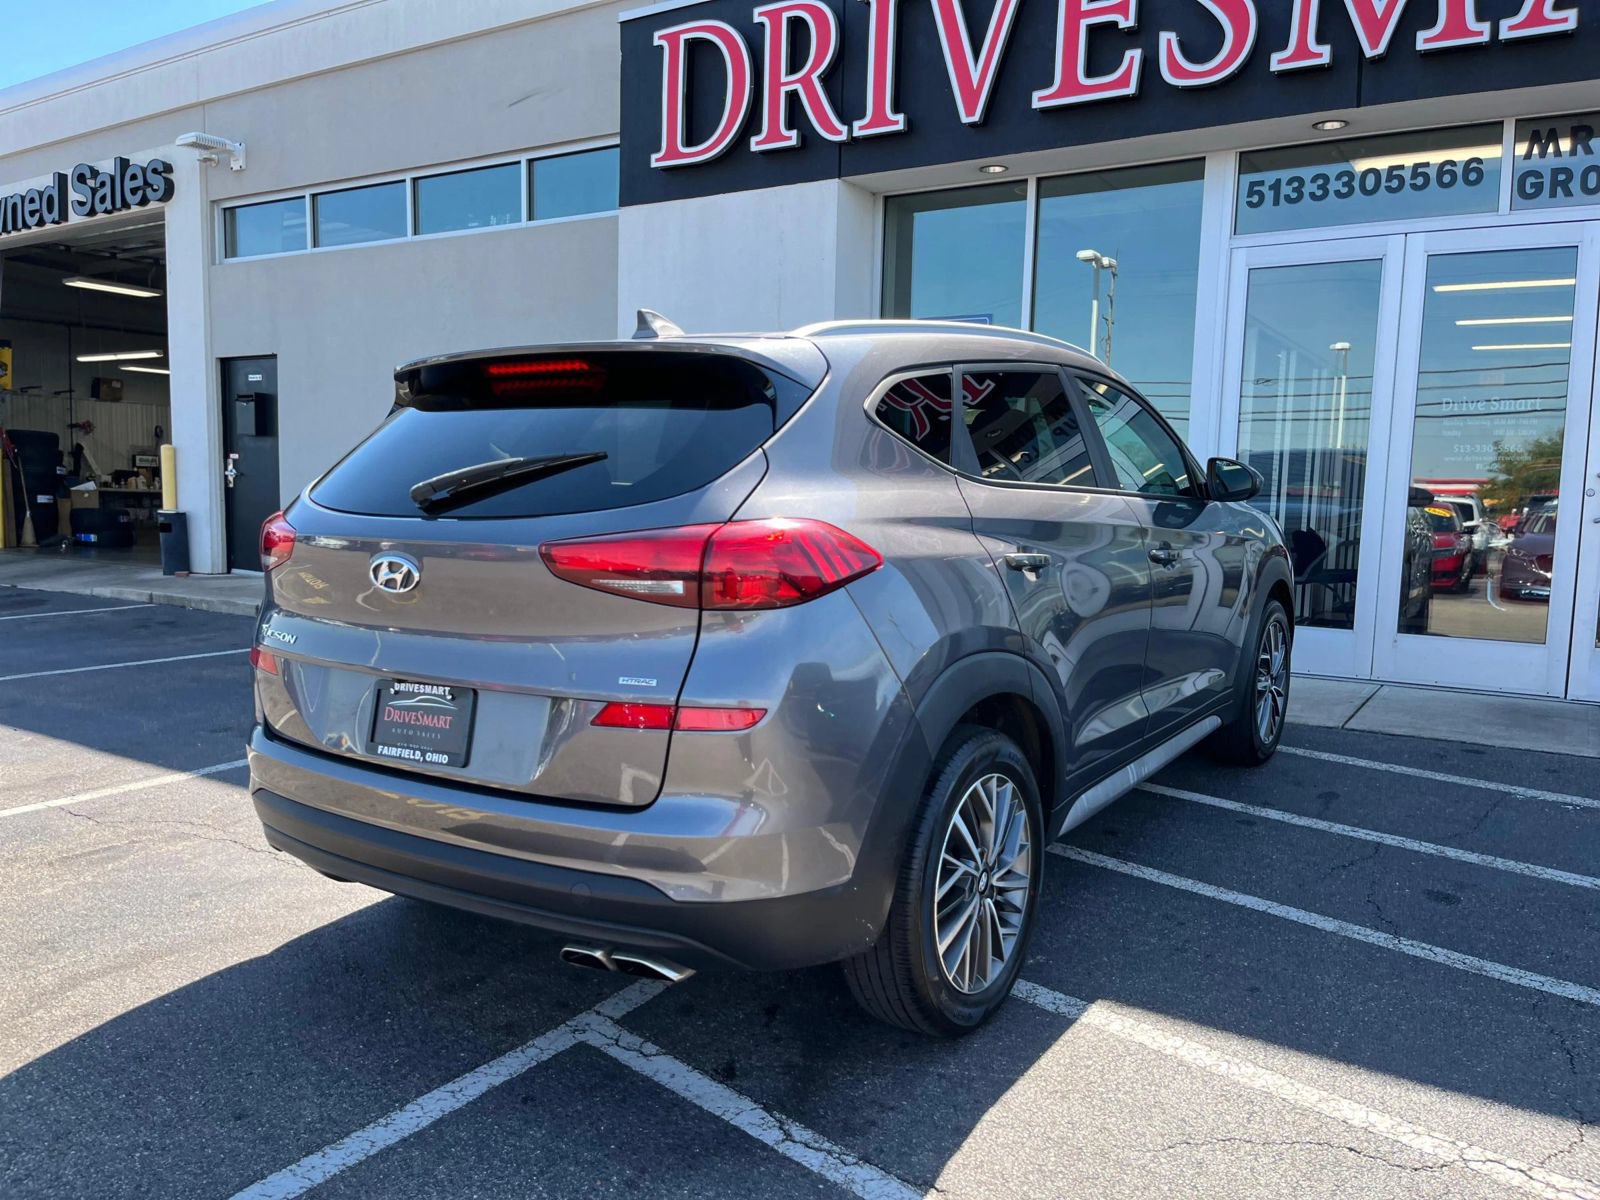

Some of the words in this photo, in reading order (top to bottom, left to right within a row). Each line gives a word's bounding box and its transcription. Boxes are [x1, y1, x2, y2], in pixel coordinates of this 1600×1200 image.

[650, 0, 1578, 168] DRIVES
[1523, 124, 1595, 160] MR
[0, 172, 69, 235] ned
[71, 156, 175, 216] Sales
[1245, 157, 1484, 209] 5133305566
[1442, 398, 1486, 412] Drive
[1490, 396, 1542, 411] Smart
[394, 682, 451, 696] DRIVESMART
[377, 745, 424, 762] FAIRFIELD,
[425, 752, 449, 764] OHIO
